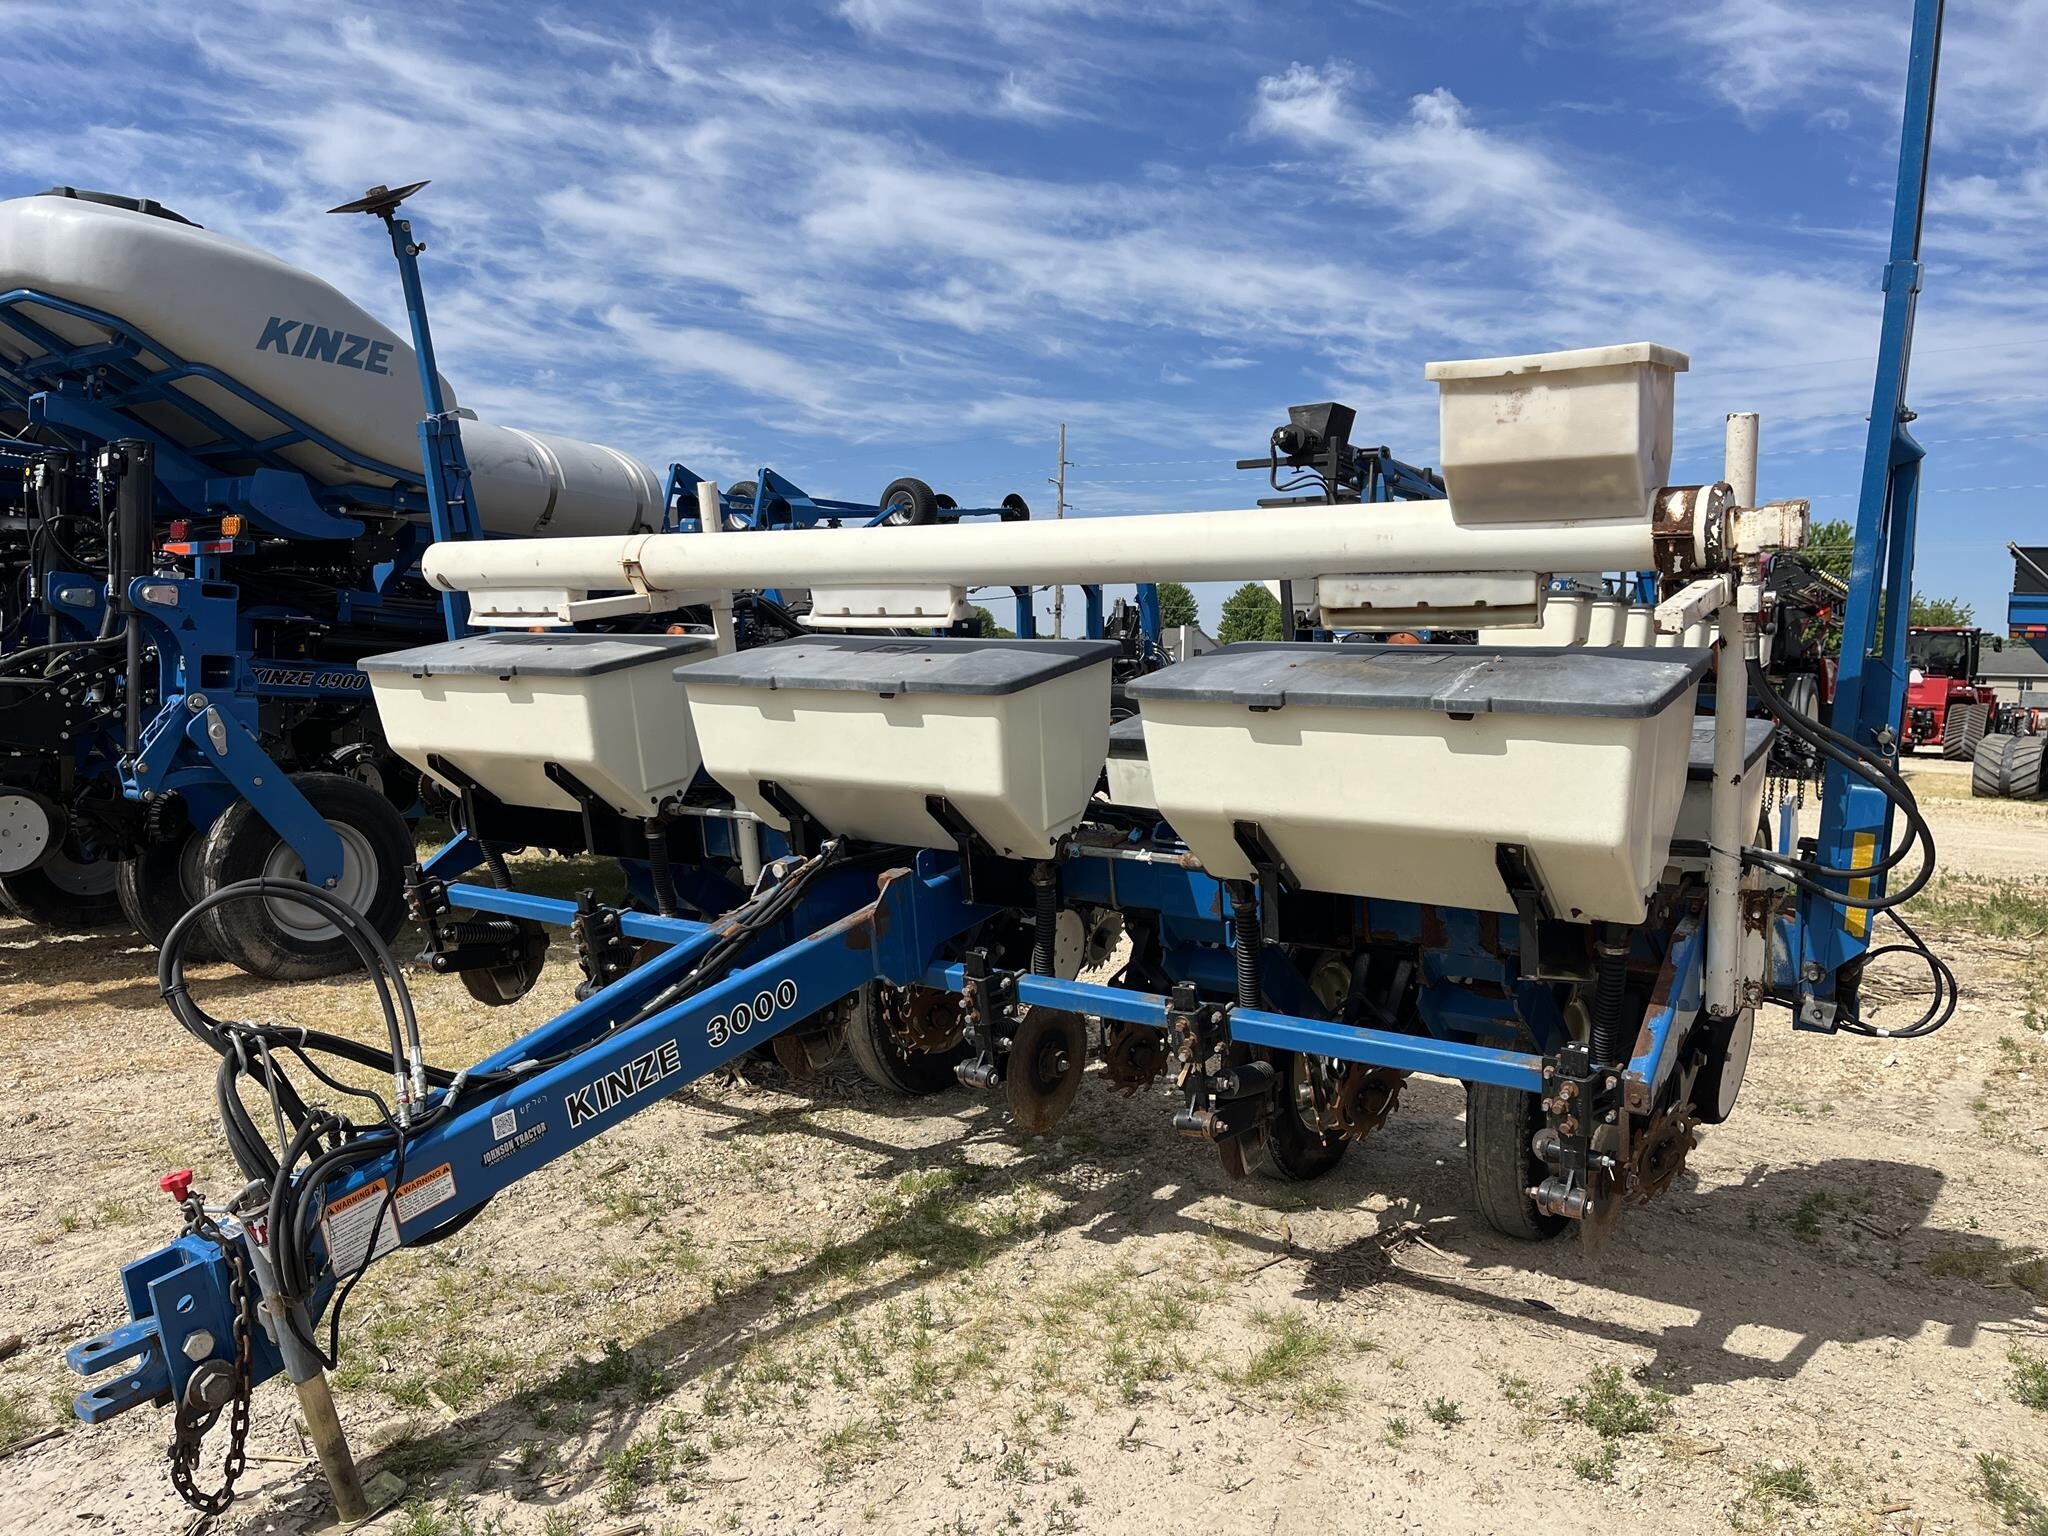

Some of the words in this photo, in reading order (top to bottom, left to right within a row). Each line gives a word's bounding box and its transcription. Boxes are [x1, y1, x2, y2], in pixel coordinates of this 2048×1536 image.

[256, 316, 394, 376] KINZE
[316, 672, 367, 691] 4900
[564, 1038, 682, 1129] KINZE
[706, 978, 798, 1048] 3000
[483, 1139, 515, 1165] JOHNSON
[514, 1122, 547, 1147] TRACTOR
[403, 1169, 442, 1194] WARNING
[334, 1187, 371, 1213] WARNING
